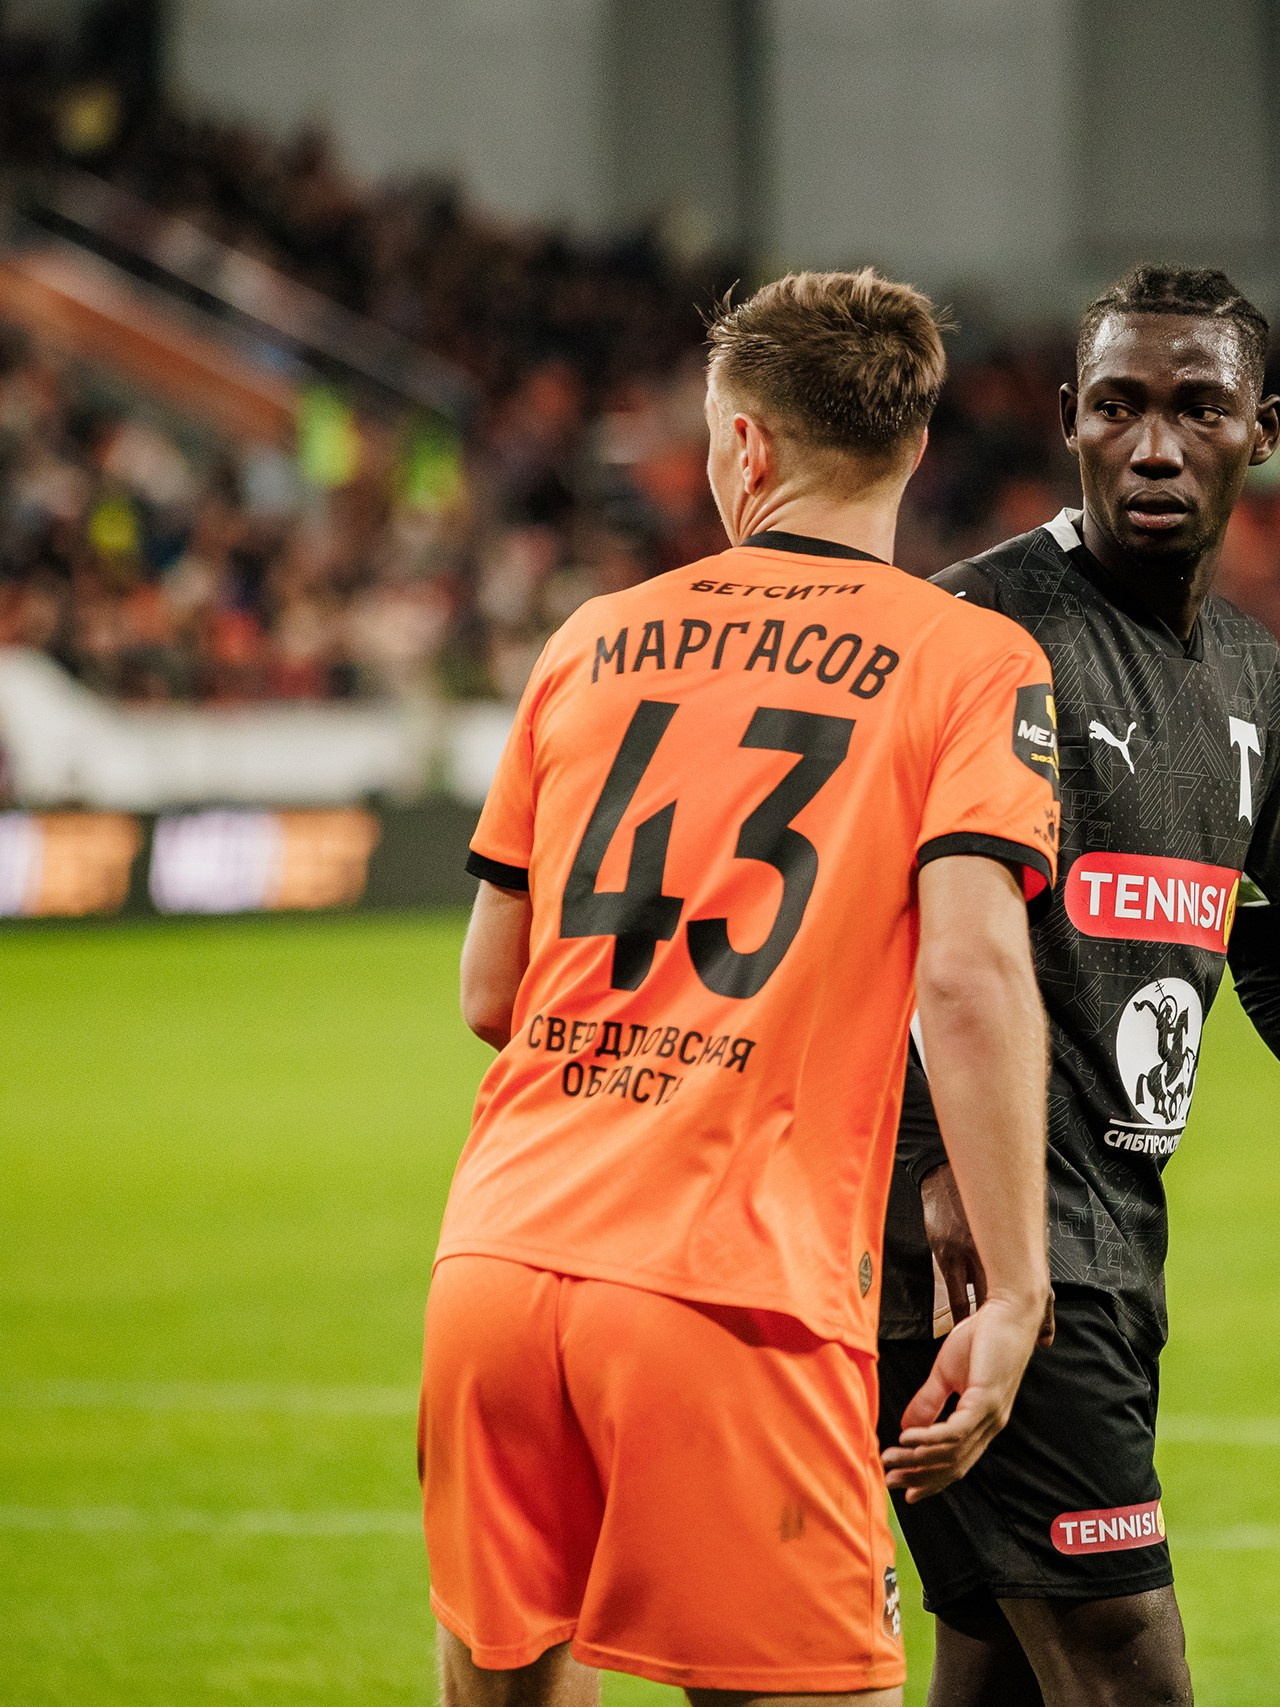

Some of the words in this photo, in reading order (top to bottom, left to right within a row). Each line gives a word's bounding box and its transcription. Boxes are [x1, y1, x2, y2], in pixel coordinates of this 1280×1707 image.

[690, 579, 866, 600] БЕТСИТИ
[591, 618, 900, 700] МАРГАСОВ
[559, 699, 857, 1000] 43
[1080, 871, 1226, 931] TENNISI
[1059, 1511, 1156, 1545] TENNISI
